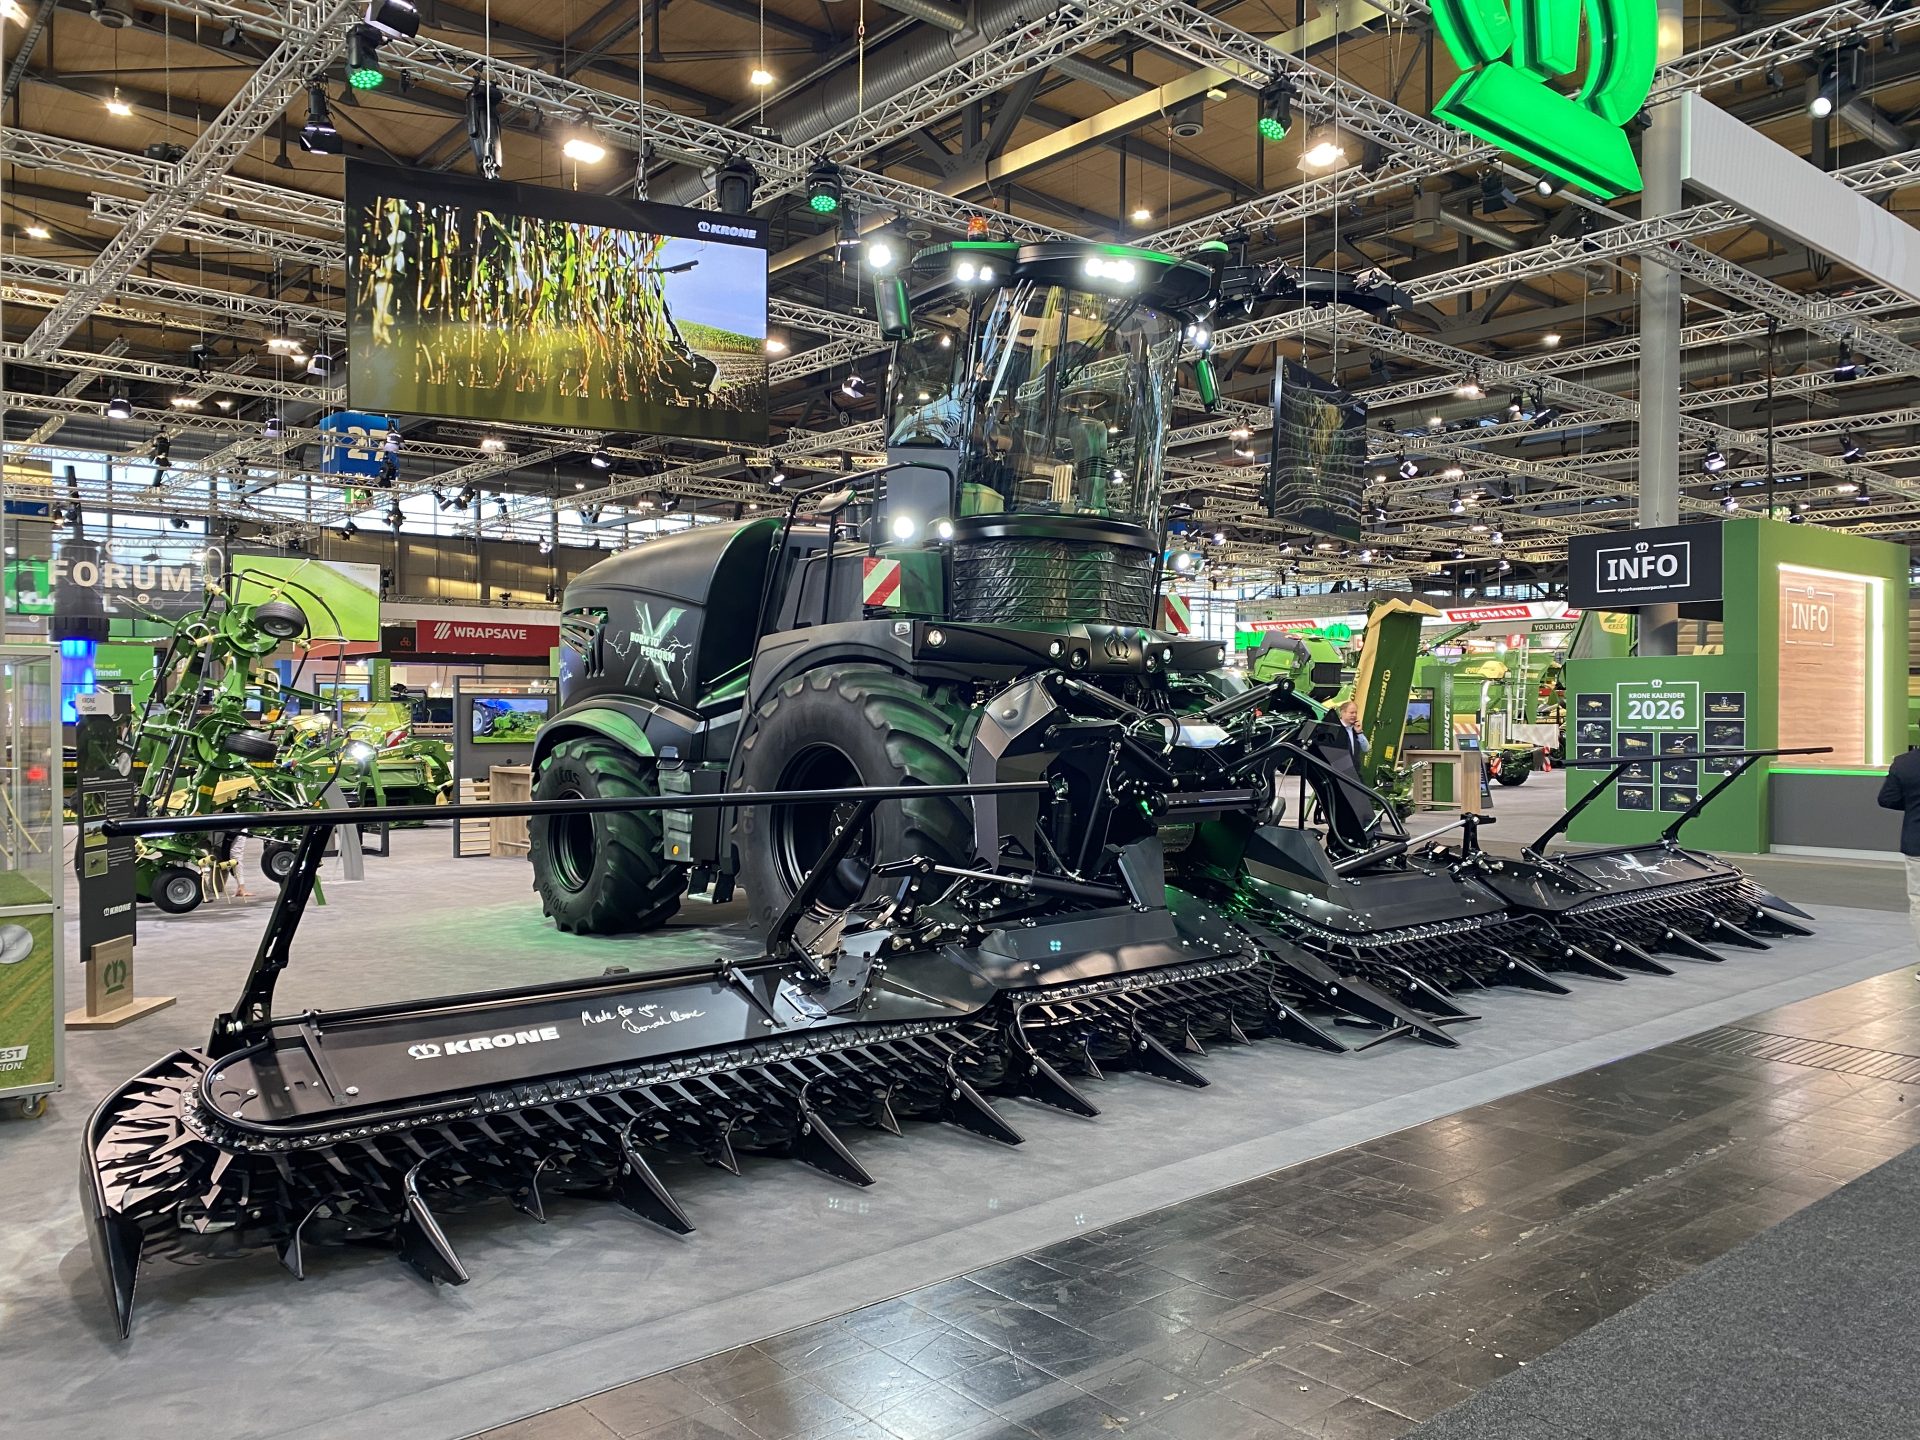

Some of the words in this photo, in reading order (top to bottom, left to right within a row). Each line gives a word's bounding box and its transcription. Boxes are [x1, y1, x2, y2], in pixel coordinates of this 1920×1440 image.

[711, 224, 757, 239] KRONE
[1607, 554, 1678, 581] INFO
[48, 560, 191, 592] FORUM
[1452, 608, 1527, 620] BERGMANN
[1791, 602, 1829, 632] INFO
[454, 627, 527, 640] WRAPSAVE
[1555, 622, 1578, 631] HARV
[630, 631, 650, 644] BORN
[650, 636, 661, 646] TO
[641, 646, 676, 662] PERFORM
[96, 668, 121, 677] innen!
[1627, 700, 1685, 720] 2026
[109, 903, 132, 916] KRONE
[581, 1009, 617, 1026] Made
[618, 1005, 633, 1018] for
[445, 1026, 560, 1056] KRONE
